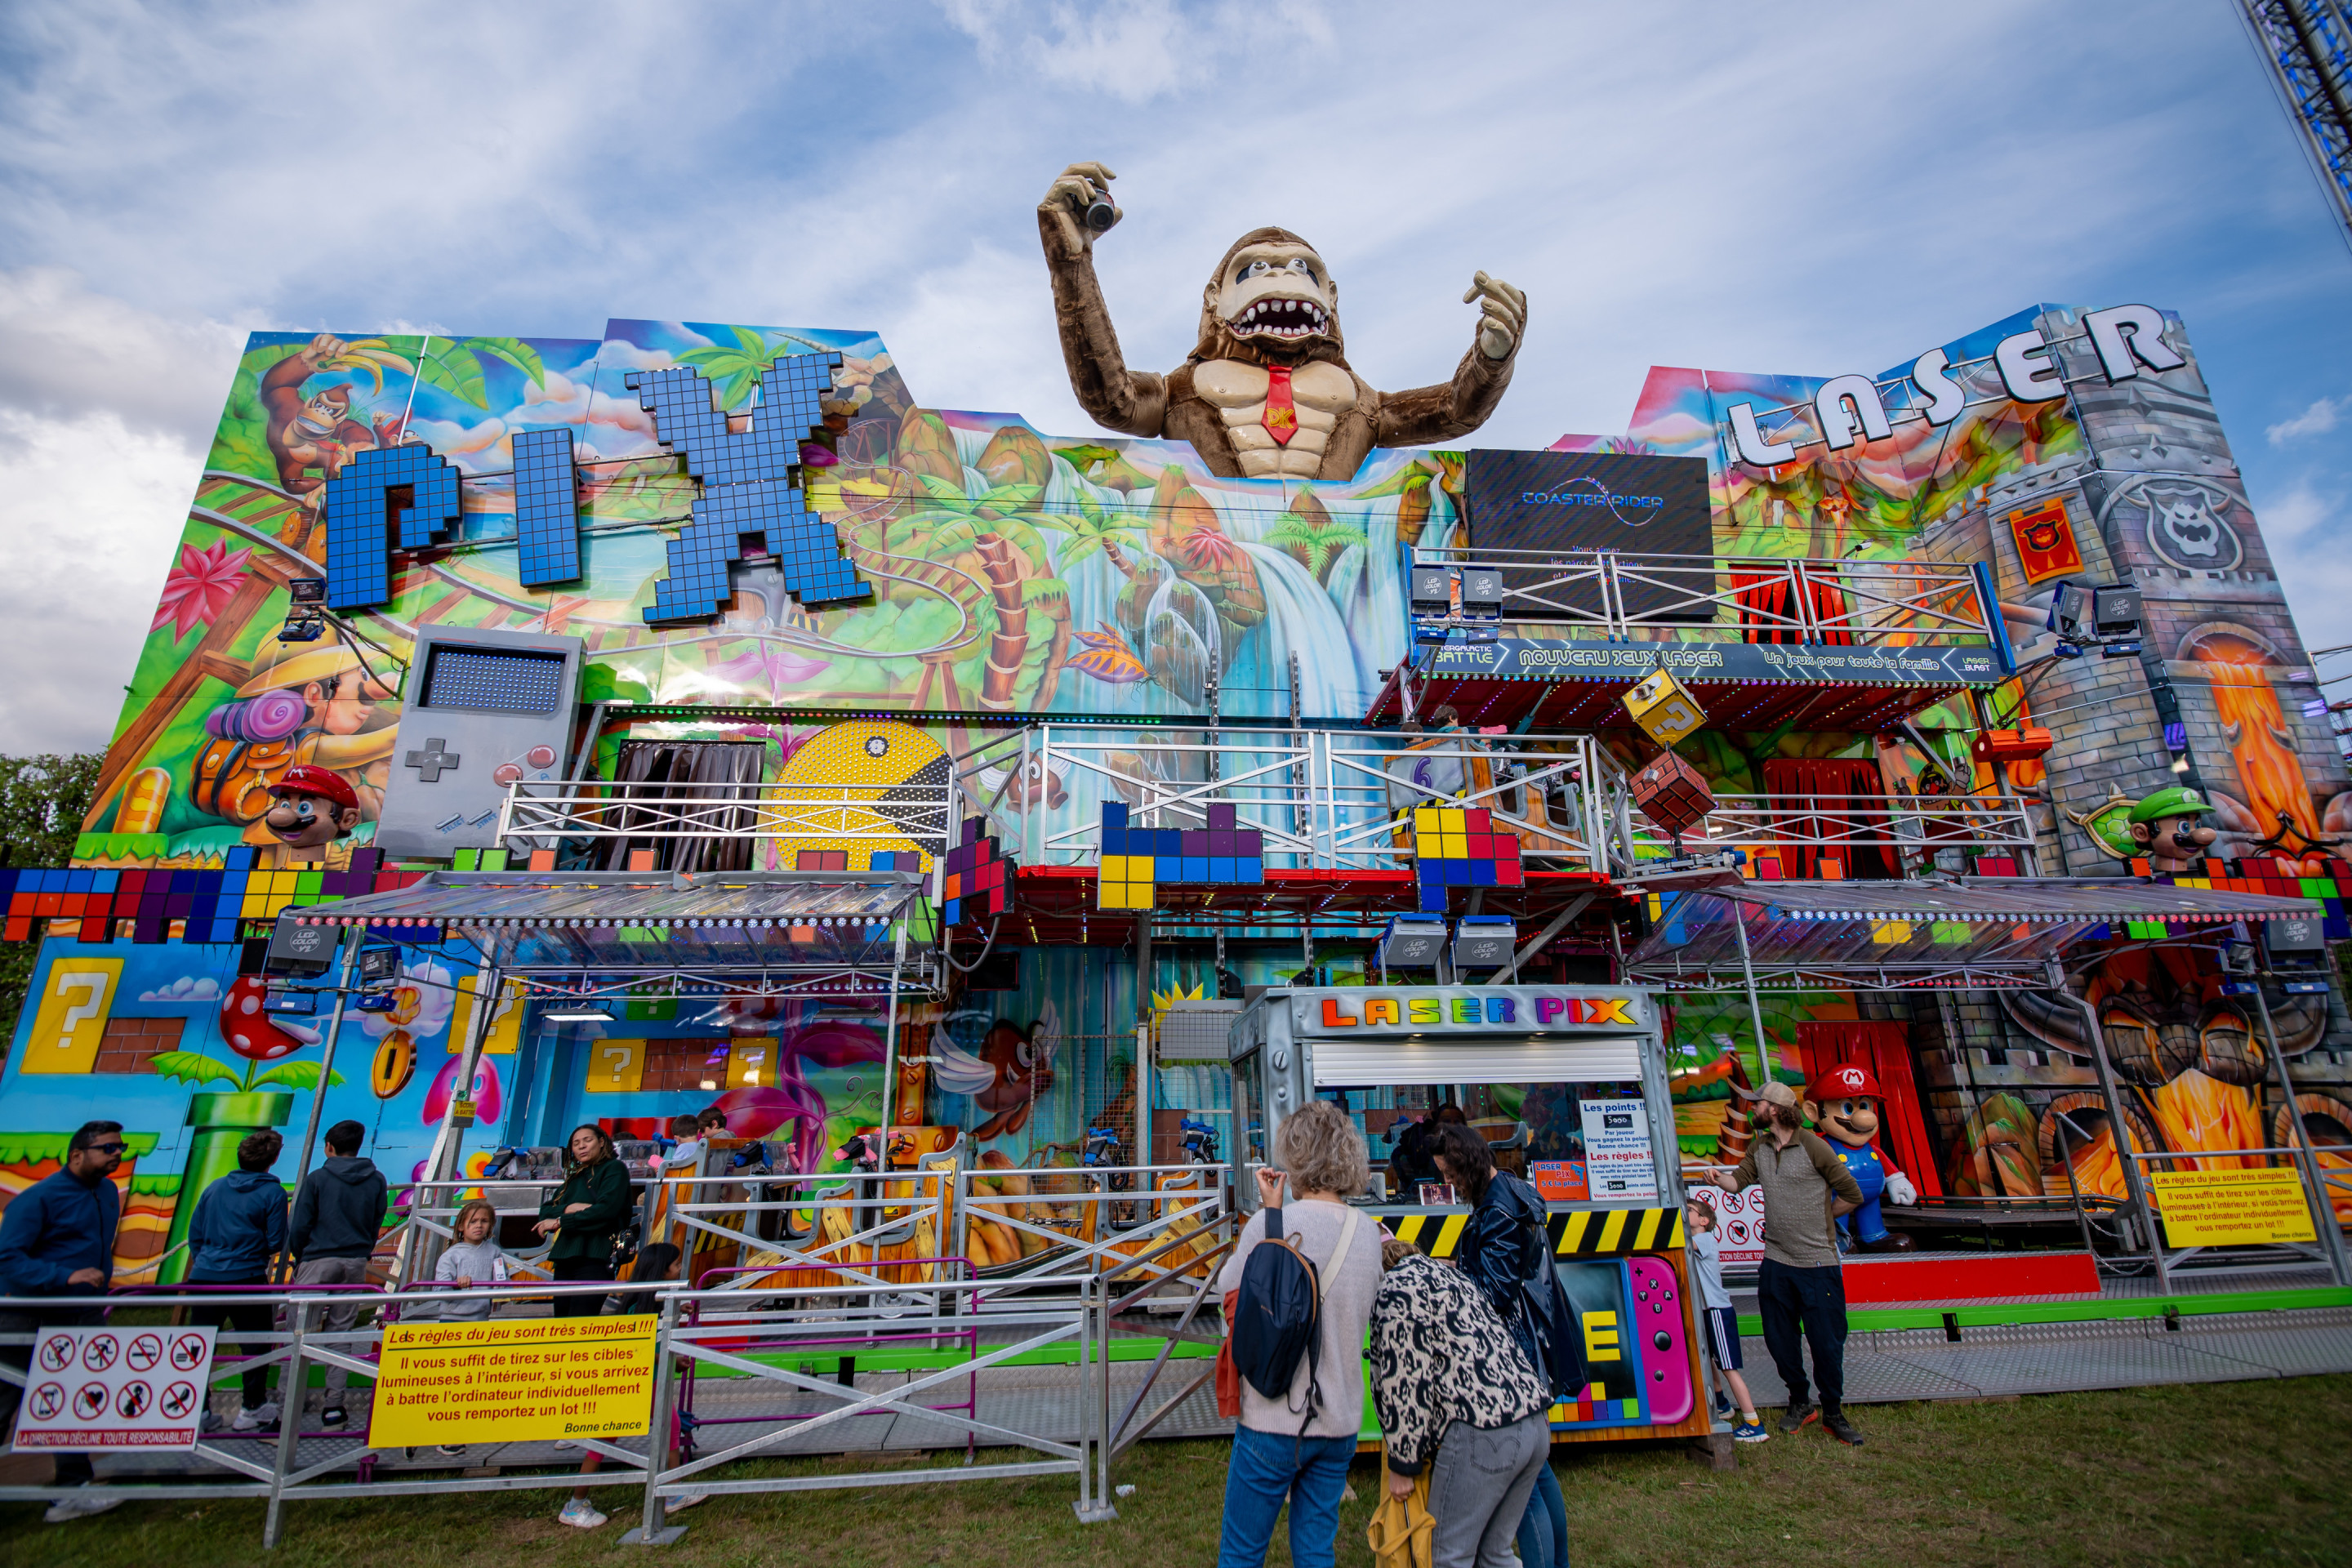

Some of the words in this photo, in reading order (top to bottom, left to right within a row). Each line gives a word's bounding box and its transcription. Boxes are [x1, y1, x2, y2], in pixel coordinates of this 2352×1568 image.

[1726, 303, 2188, 468] LASER
[1266, 407, 1294, 429] DK
[1522, 492, 1607, 506] COASTER
[1611, 495, 1664, 508] RIDER
[1519, 649, 1610, 666] NOUVEAU
[1612, 650, 1658, 666] JEUX
[1661, 650, 1724, 666] LASER
[1764, 652, 1784, 665] Un
[1786, 653, 1815, 669] jeux
[1817, 657, 1845, 669] pour
[1847, 656, 1883, 668] toute
[1885, 657, 1897, 668] la
[442, 817, 465, 835] SELECT
[476, 813, 497, 829] START
[1321, 998, 1516, 1027] LASER
[1535, 998, 1639, 1026] PIX
[1846, 1071, 1862, 1082] M
[1584, 1103, 1601, 1111] Les
[1606, 1102, 1637, 1113] points
[1607, 1116, 1627, 1124] 5000
[1590, 1152, 1609, 1160] Les
[1612, 1152, 1644, 1161] règles
[2155, 1177, 2170, 1185] Les
[2172, 1174, 2195, 1185] règles
[2197, 1174, 2207, 1183] du
[2208, 1174, 2221, 1184] jeu
[2222, 1174, 2239, 1182] sont
[2241, 1173, 2256, 1181] très
[2257, 1172, 2287, 1181] simples
[2167, 1192, 2173, 1200] Il
[2175, 1192, 2193, 1200] vous
[2195, 1190, 2215, 1199] suffit
[2216, 1190, 2225, 1198] de
[2225, 1189, 2243, 1197] tirez
[2162, 1203, 2206, 1212] lumineuses
[2207, 1201, 2212, 1209] à
[2280, 1198, 2305, 1206] arrivez
[2169, 1214, 2175, 1222] à
[2175, 1213, 2198, 1222] battre
[2243, 1208, 2304, 1218] individuellement
[2215, 1223, 2252, 1232] remportez
[389, 1330, 415, 1343] Les
[419, 1329, 462, 1344] règles
[466, 1328, 484, 1341] du
[486, 1326, 510, 1343] jeu
[514, 1325, 546, 1339] sont
[549, 1323, 576, 1336] très
[579, 1321, 634, 1336] simples
[400, 1357, 409, 1370] Il
[412, 1356, 446, 1369] vous
[450, 1352, 486, 1367] suffit
[490, 1352, 506, 1365] de
[510, 1352, 540, 1365] tirez
[544, 1352, 566, 1363] sur
[569, 1348, 590, 1362] les
[593, 1348, 634, 1361] cibles
[381, 1375, 461, 1388] lumineuses
[465, 1371, 474, 1385] à
[549, 1368, 562, 1380] si
[565, 1369, 599, 1380] vous
[603, 1365, 650, 1378] arrivez
[386, 1392, 394, 1405] à
[399, 1392, 439, 1405] battre
[527, 1381, 640, 1399] individuellement
[427, 1409, 461, 1422] vous
[466, 1404, 536, 1420] remportez
[540, 1405, 557, 1416] un
[560, 1402, 579, 1415] lot
[564, 1422, 600, 1433] Bonne
[602, 1420, 642, 1432] chance
[17, 1432, 29, 1444] LA
[29, 1432, 69, 1444] DIRECTION
[69, 1429, 100, 1444] DÉCLINE
[103, 1432, 127, 1444] TOUTE
[128, 1430, 192, 1444] RESPONSABILITÉ
